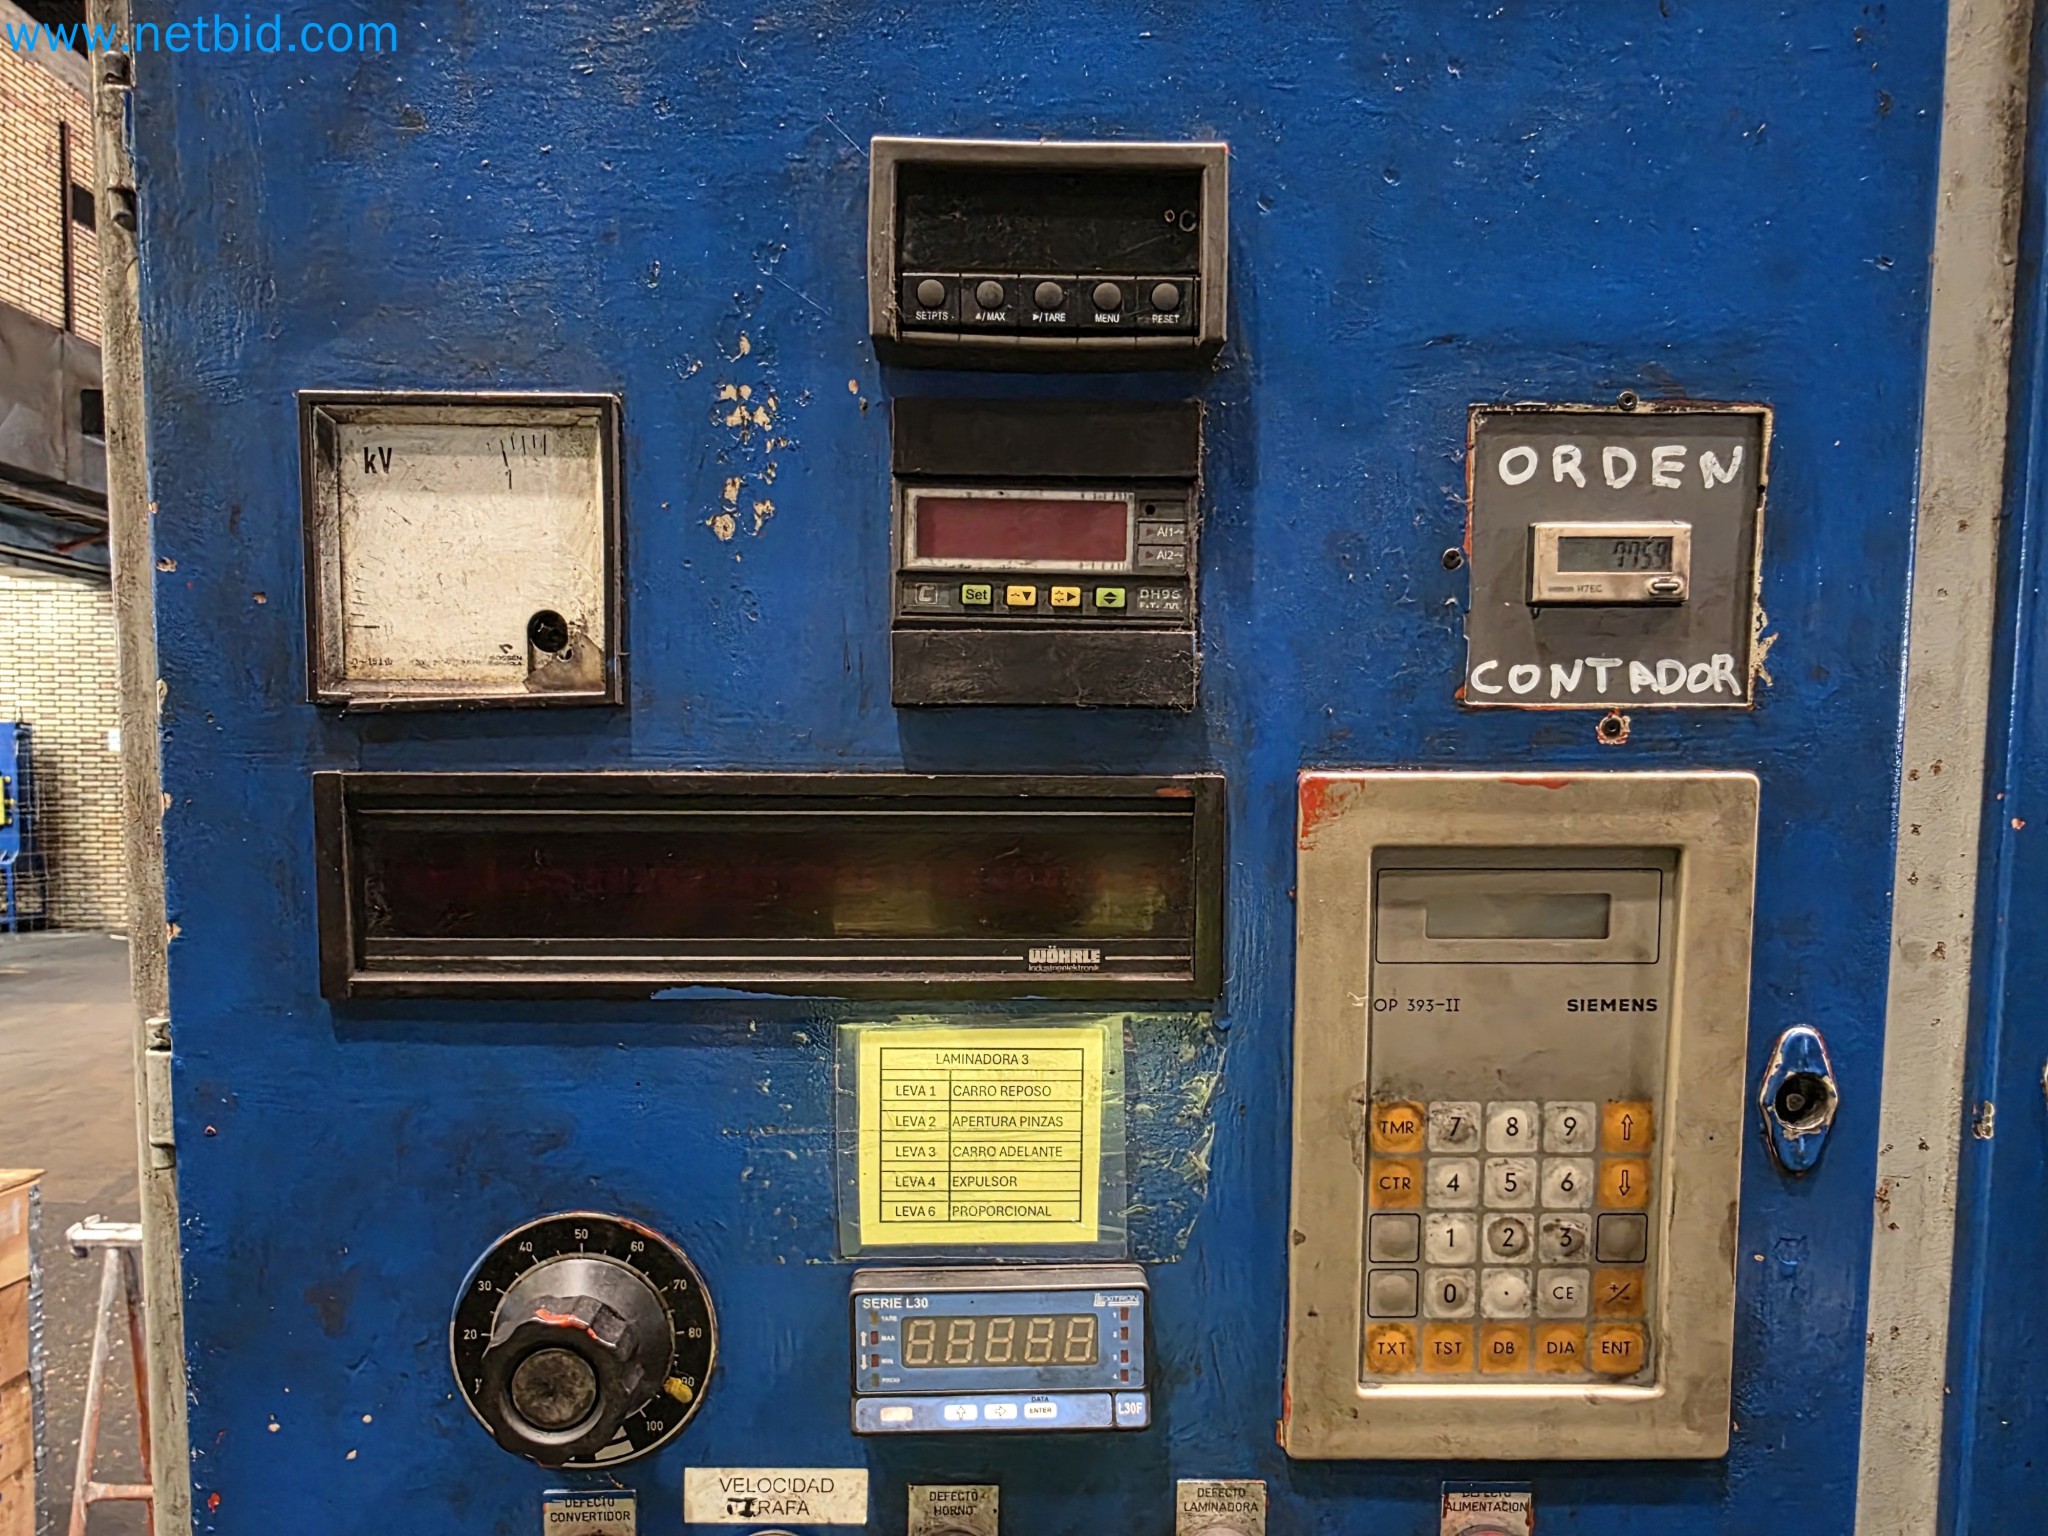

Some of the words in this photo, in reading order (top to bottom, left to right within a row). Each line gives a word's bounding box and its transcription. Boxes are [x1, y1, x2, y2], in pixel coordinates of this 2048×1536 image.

[916, 312, 948, 320] SETPTS
[1095, 313, 1120, 323] MENU
[1152, 314, 1179, 323] RESET
[364, 446, 392, 474] kV
[1499, 445, 1743, 489] ORDEN
[965, 588, 988, 600] Set
[1471, 653, 1742, 699] CONTADOR
[1028, 945, 1100, 964] WÖHRLE
[1374, 998, 1398, 1012] OP
[1407, 998, 1460, 1012] 393-II
[1567, 998, 1658, 1012] SIEMENS
[936, 1053, 1019, 1065] LAMINADORA
[1021, 1054, 1029, 1065] 3
[895, 1085, 928, 1097] LEVA
[929, 1085, 937, 1097] 1
[952, 1085, 997, 1097] CARRO
[1000, 1085, 1052, 1097] REPOSO
[895, 1116, 927, 1127] LEVA
[929, 1116, 936, 1127] 2
[952, 1116, 1017, 1127] APERTURA
[1019, 1116, 1064, 1127] PINZAS
[1380, 1120, 1414, 1134] TMR
[1449, 1117, 1462, 1137] 7
[1506, 1116, 1519, 1137] 8
[1563, 1117, 1577, 1137] 9
[895, 1146, 927, 1158] LEVA
[929, 1146, 936, 1158] 3
[952, 1146, 996, 1158] CARRO
[999, 1146, 1063, 1158] ADELANTE
[895, 1176, 927, 1188] LEVA
[927, 1176, 936, 1188] 4
[952, 1176, 1018, 1188] EXPULSOR
[1379, 1176, 1411, 1190] CTR
[1446, 1173, 1460, 1192] 4
[1504, 1172, 1517, 1192] 5
[1560, 1172, 1574, 1192] 6
[895, 1206, 927, 1217] LEVA
[928, 1206, 936, 1217] 6
[952, 1206, 1052, 1217] PROPORCIONAL
[574, 1229, 589, 1240] 50
[1446, 1228, 1455, 1248] 1
[1502, 1228, 1515, 1248] 2
[1559, 1228, 1572, 1248] 3
[519, 1241, 533, 1253] 40
[630, 1241, 645, 1253] 60
[477, 1280, 492, 1292] 30
[672, 1279, 687, 1291] 70
[1443, 1283, 1457, 1303] 0
[1553, 1286, 1574, 1300] CE
[862, 1298, 902, 1309] SERIE
[906, 1298, 928, 1309] L30
[463, 1329, 478, 1340] 20
[688, 1327, 702, 1338] 80
[1377, 1341, 1407, 1355] TXT
[1434, 1341, 1463, 1355] TST
[1493, 1341, 1515, 1355] DB
[1546, 1341, 1576, 1355] DIA
[1601, 1341, 1632, 1355] ENT
[1118, 1402, 1143, 1415] L30F
[645, 1420, 664, 1432] 100
[719, 1477, 835, 1493] VELOCIDAD
[929, 1491, 979, 1502] DEFECTO
[1197, 1487, 1246, 1498] DEFECTO
[933, 1505, 974, 1516] HORNO
[1184, 1502, 1259, 1512] LAMINADORA
[1446, 1502, 1527, 1512] ALIMENTACION
[550, 1510, 631, 1523] CONVERTIDOR
